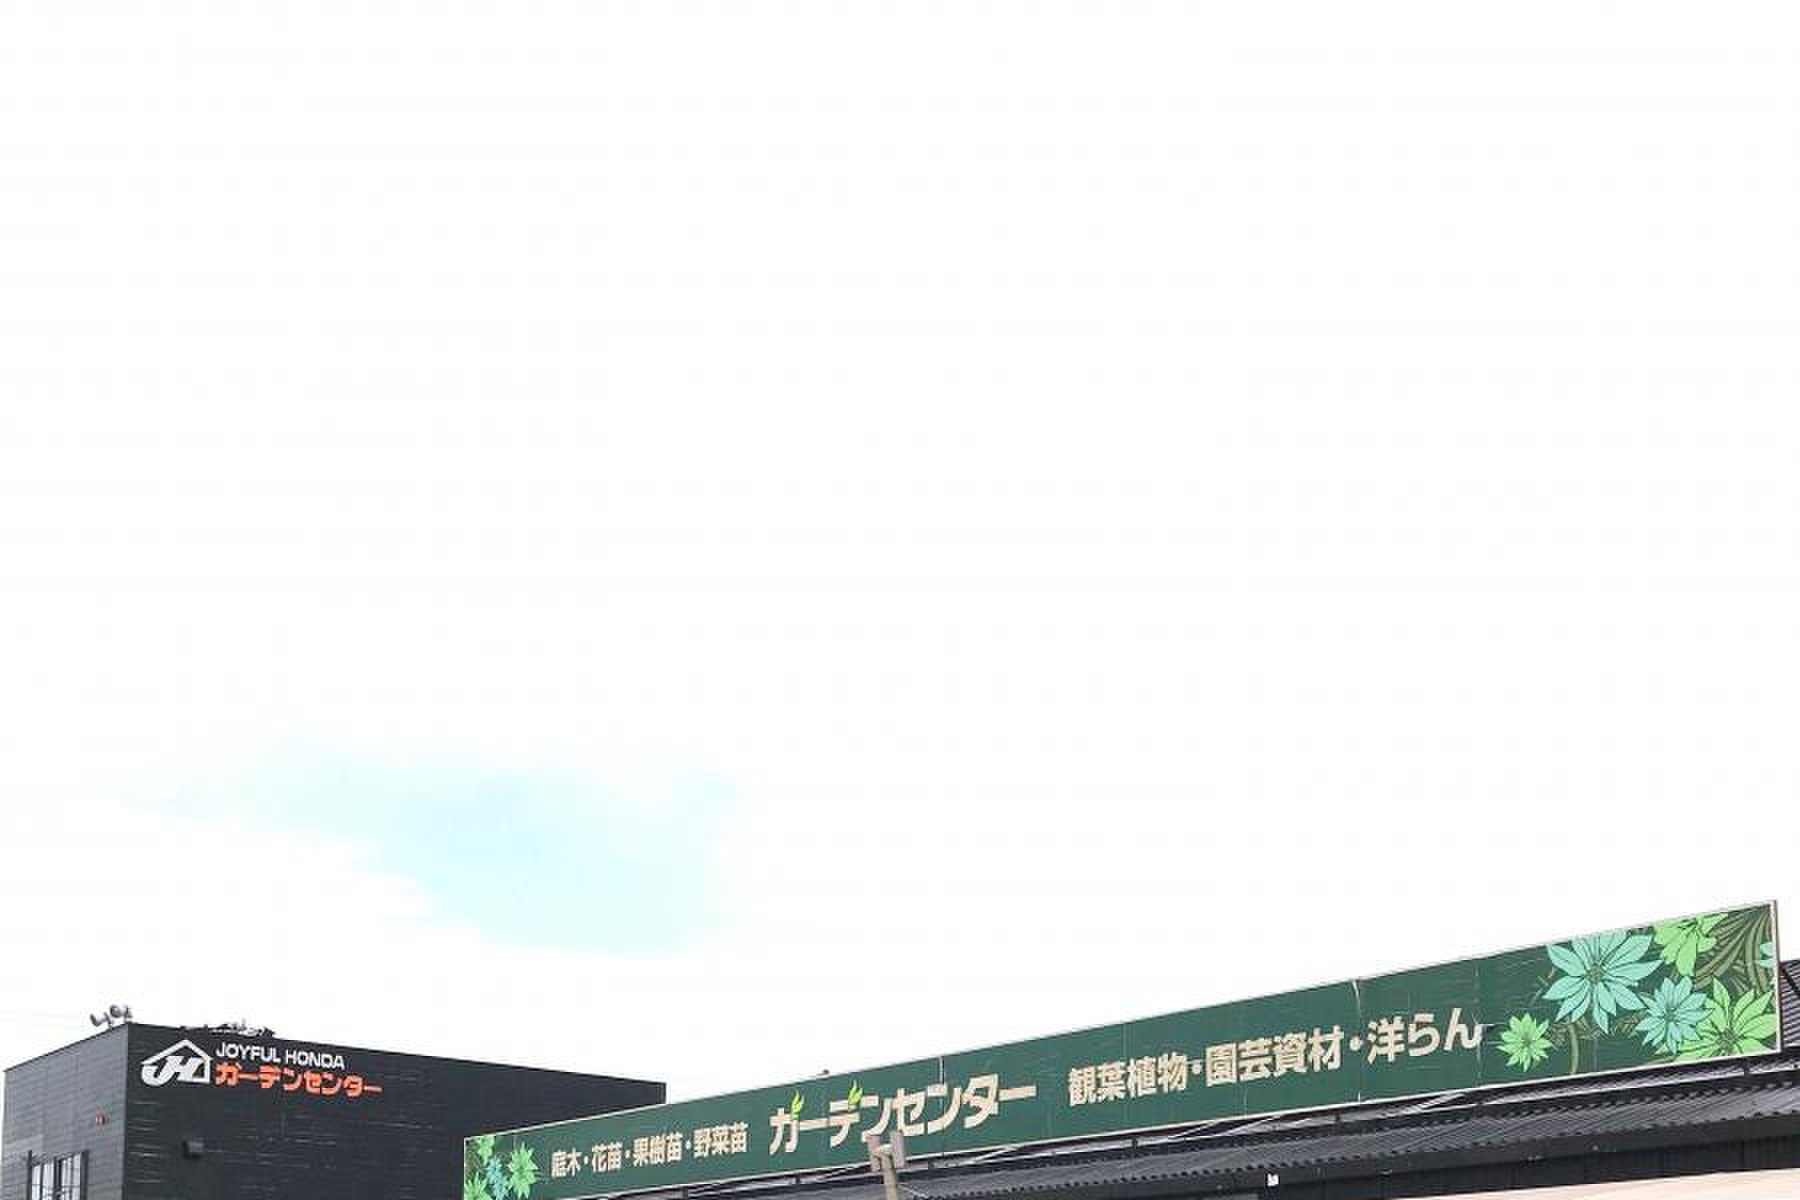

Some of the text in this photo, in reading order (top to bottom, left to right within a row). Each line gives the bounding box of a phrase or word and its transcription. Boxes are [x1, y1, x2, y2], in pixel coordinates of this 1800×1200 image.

[216, 1042, 345, 1070] JOYFUL HONDA
[215, 1062, 383, 1097] ガーデンセンター
[769, 1074, 1037, 1155] ガーデンセンター
